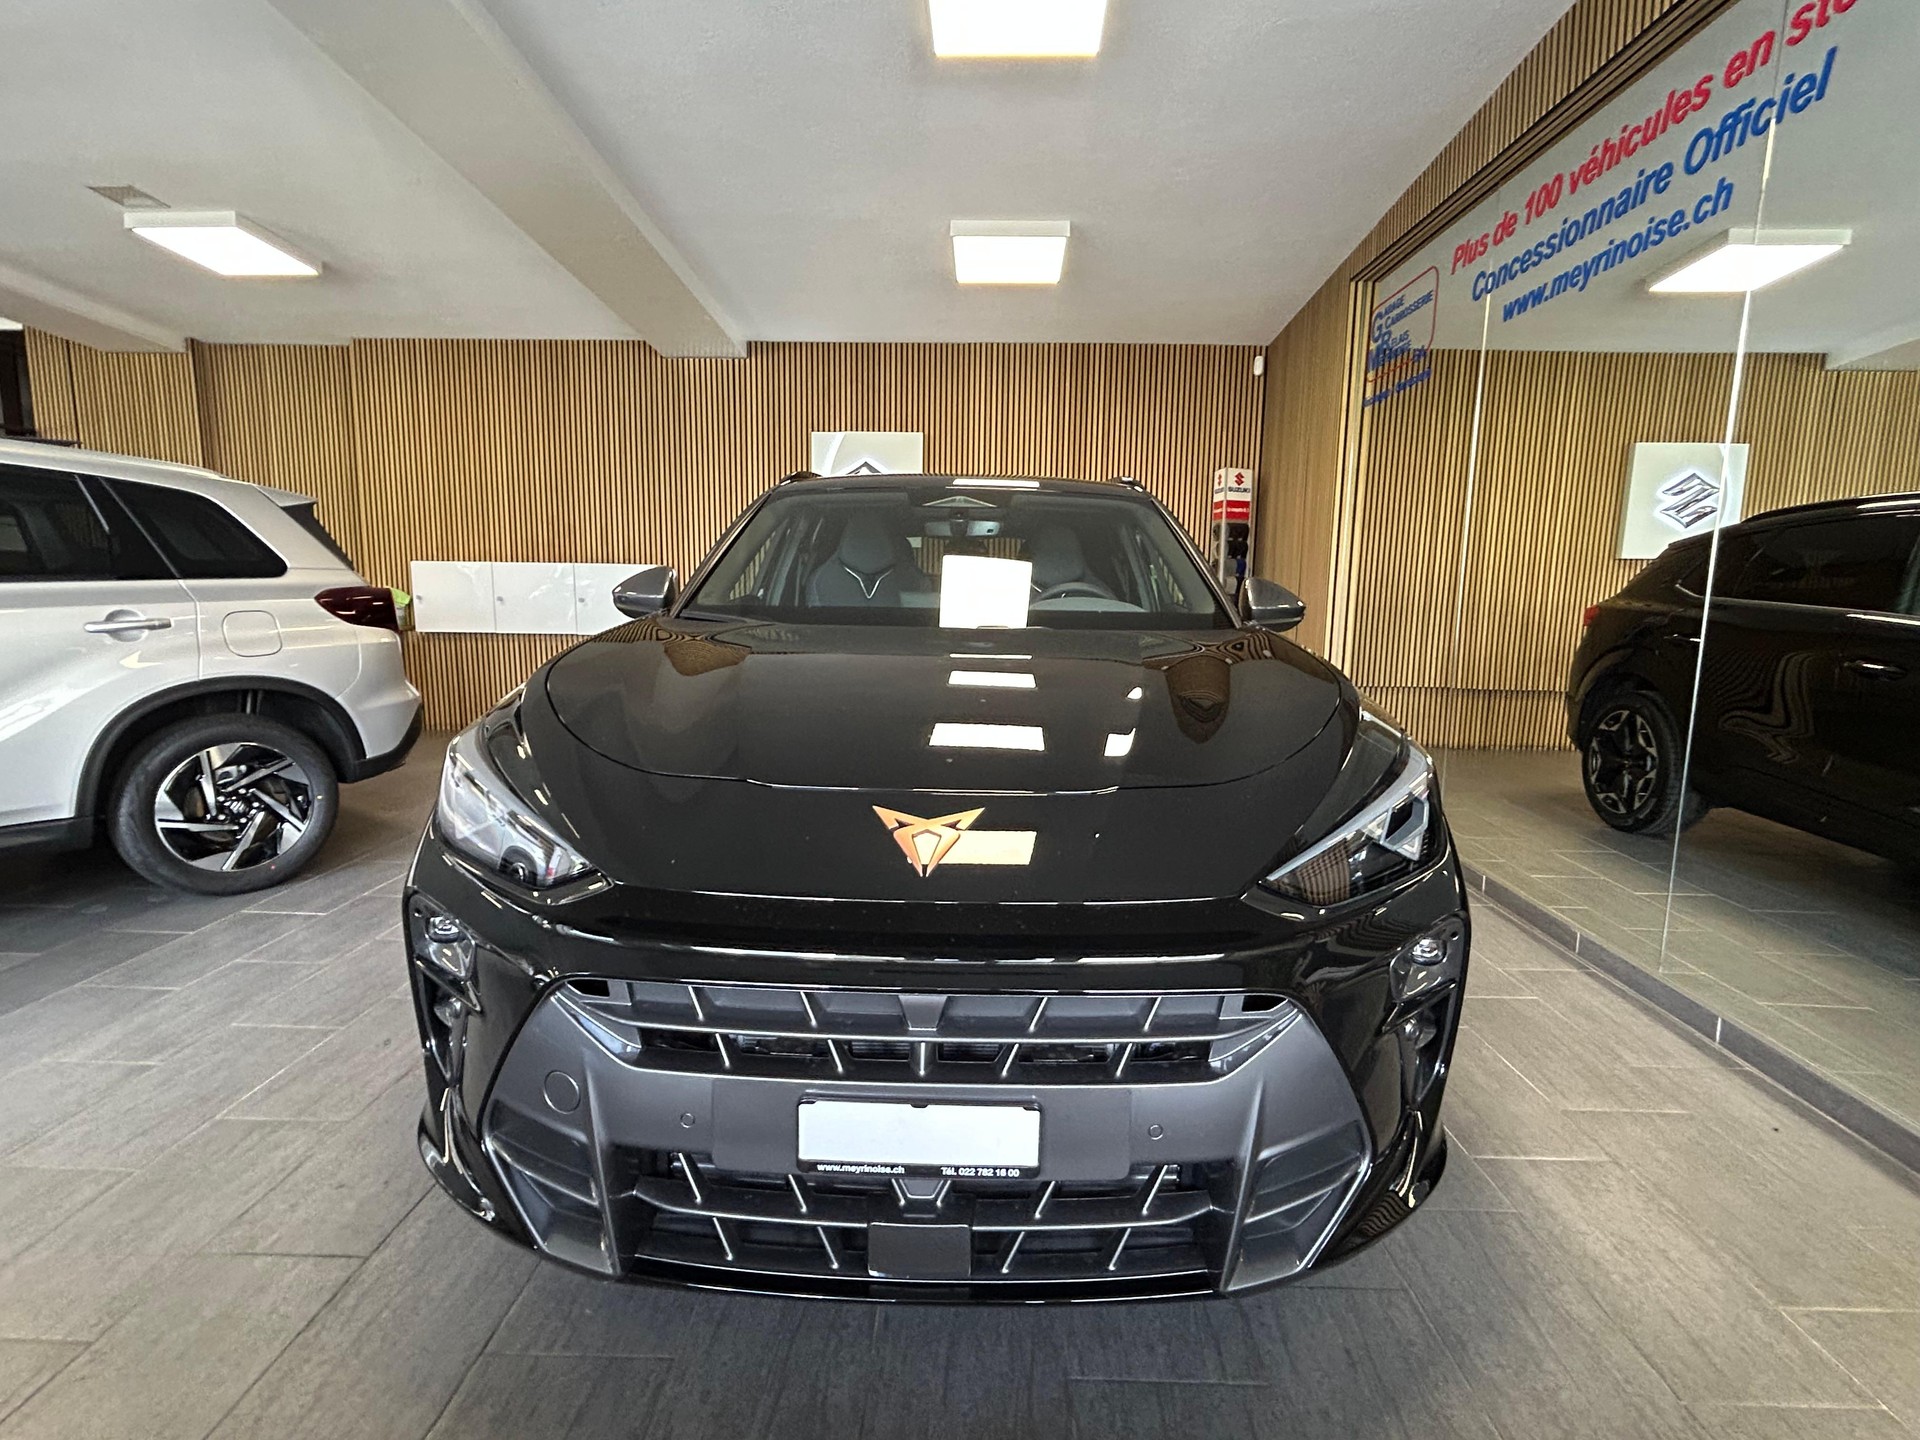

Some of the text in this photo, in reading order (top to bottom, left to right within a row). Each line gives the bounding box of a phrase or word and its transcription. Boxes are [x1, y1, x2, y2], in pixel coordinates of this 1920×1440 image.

[1451, 233, 1490, 275] Plus
[1492, 211, 1518, 246] de
[1524, 173, 1564, 225] 100
[1569, 74, 1713, 194] véhicules
[1723, 30, 1776, 88] en
[1473, 46, 1838, 301] Concessionnaire Officiel
[1502, 177, 1734, 323] www.meyrinoise.ch
[1227, 486, 1251, 494] SUZUKI
[816, 1163, 905, 1174] www.meyrinoise.ch
[958, 1167, 976, 1177] 022
[977, 1167, 994, 1177] 782
[1008, 1168, 1020, 1178] 00
